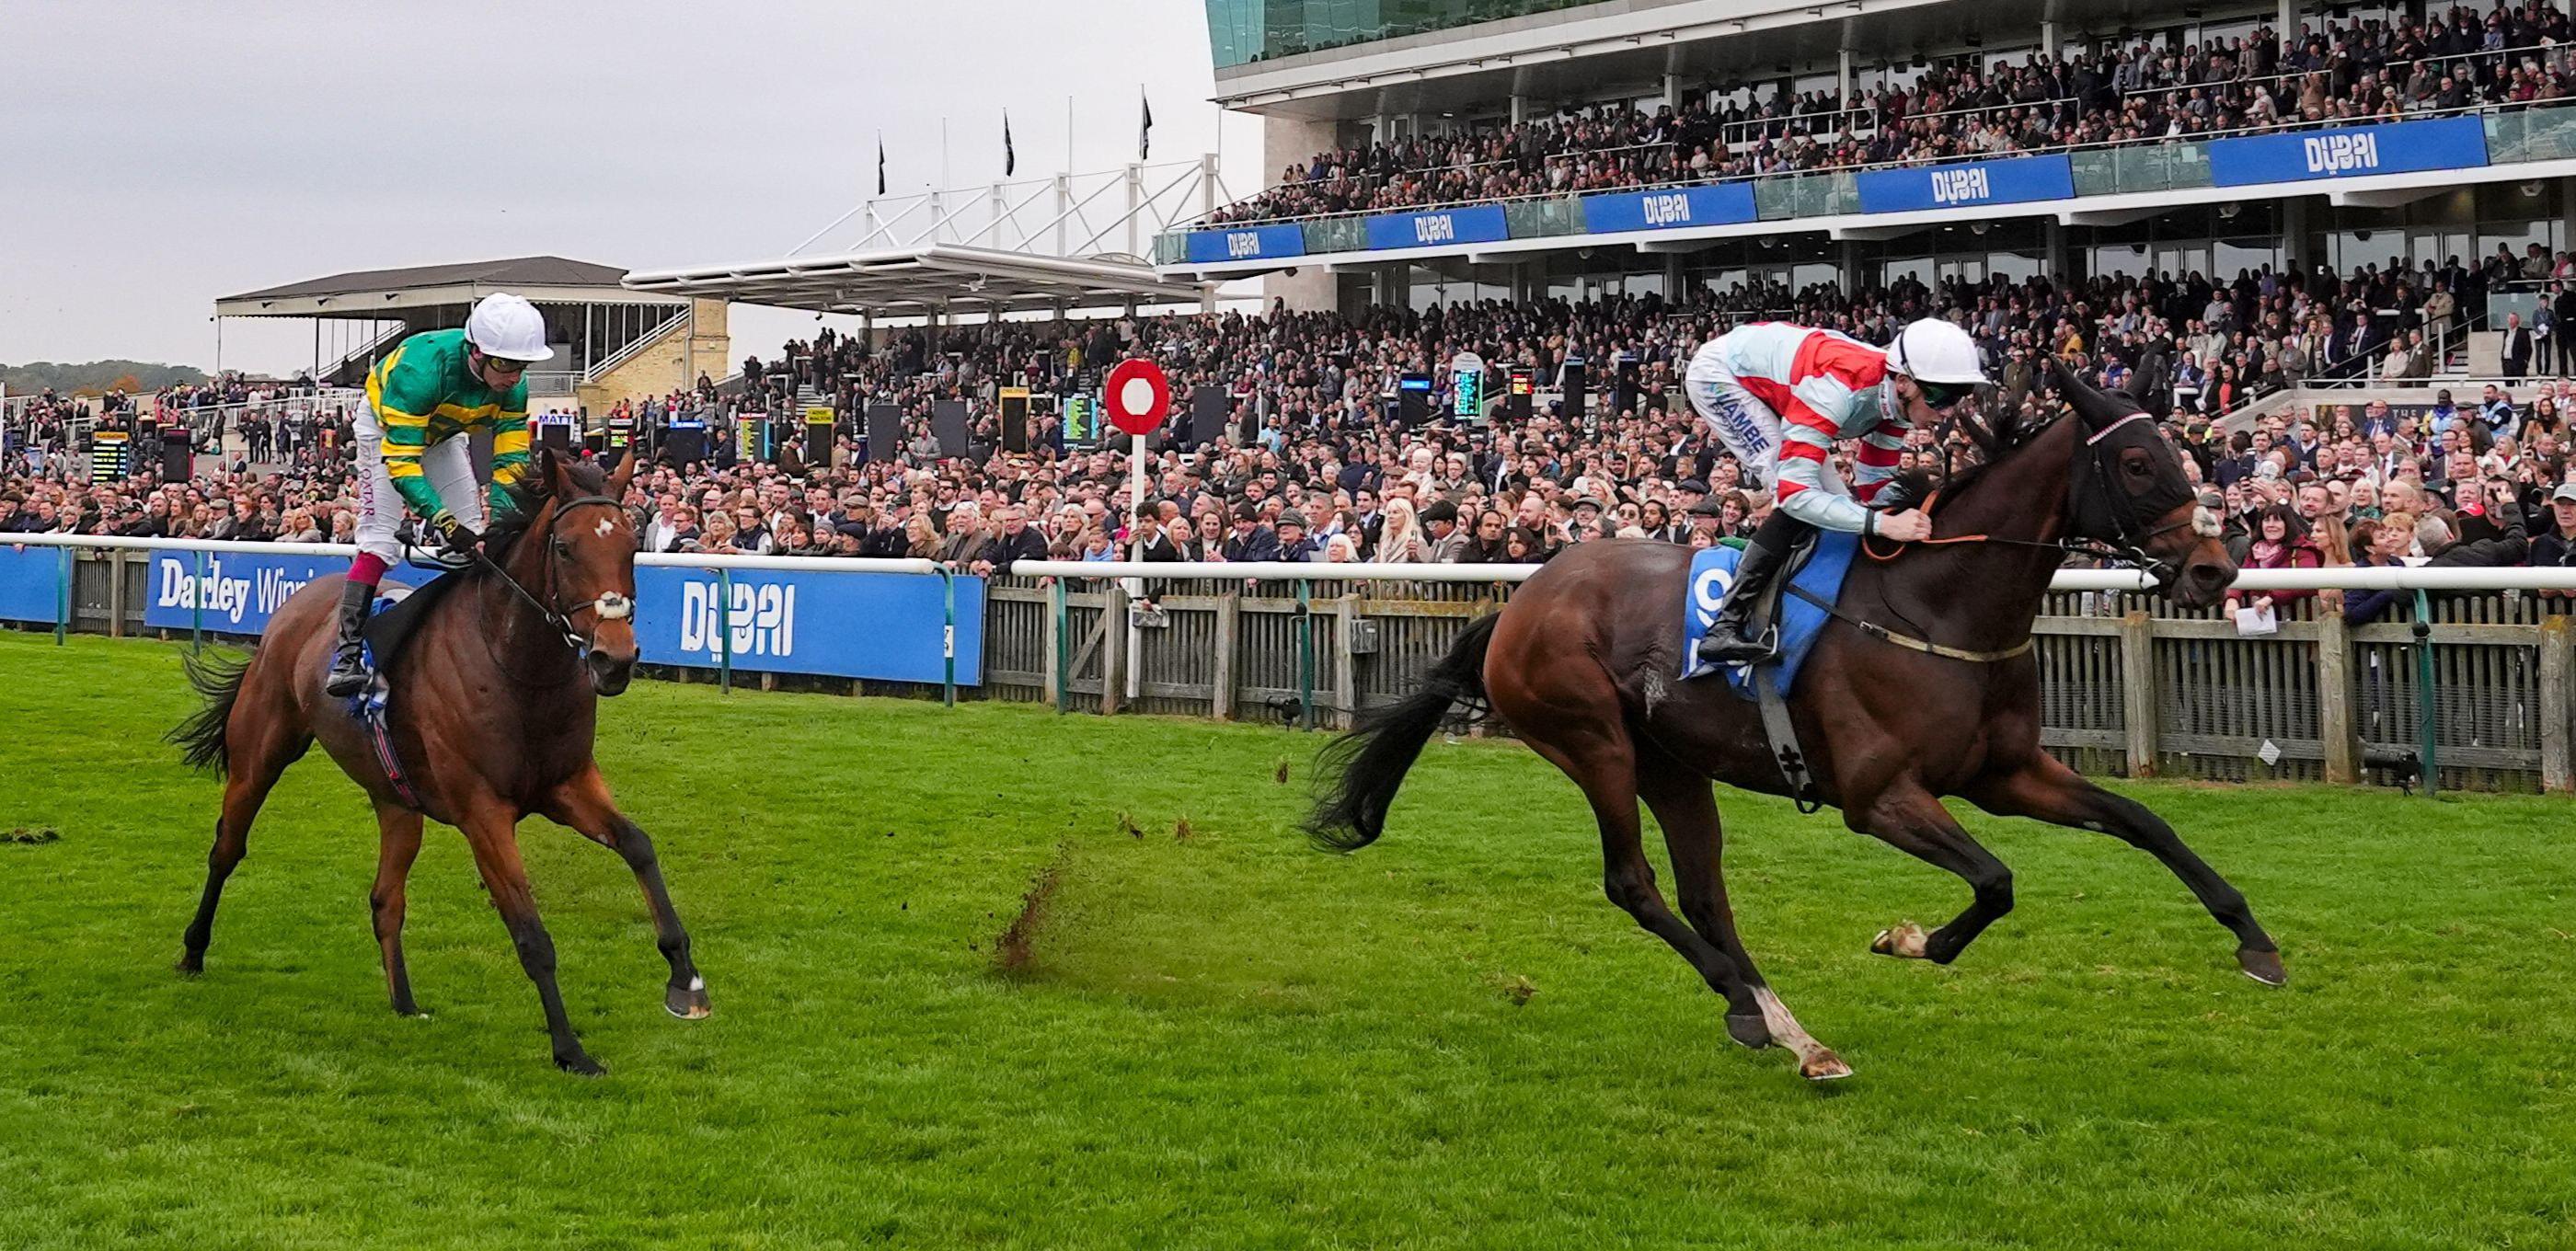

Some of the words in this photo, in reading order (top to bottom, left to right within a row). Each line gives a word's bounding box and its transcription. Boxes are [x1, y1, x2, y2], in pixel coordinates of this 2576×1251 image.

[2304, 132, 2378, 175] DUBAI
[1931, 167, 1989, 204] DUBAI
[1413, 213, 1454, 245] DUBAI
[1642, 193, 1690, 226] DUBAI
[1227, 231, 1261, 258] DUBAI
[538, 415, 572, 423] MATT
[362, 468, 375, 516] QATAR
[158, 558, 250, 624] Darley
[257, 568, 314, 614] Win
[1694, 568, 1734, 627] 9
[680, 581, 796, 662] DUBAI
